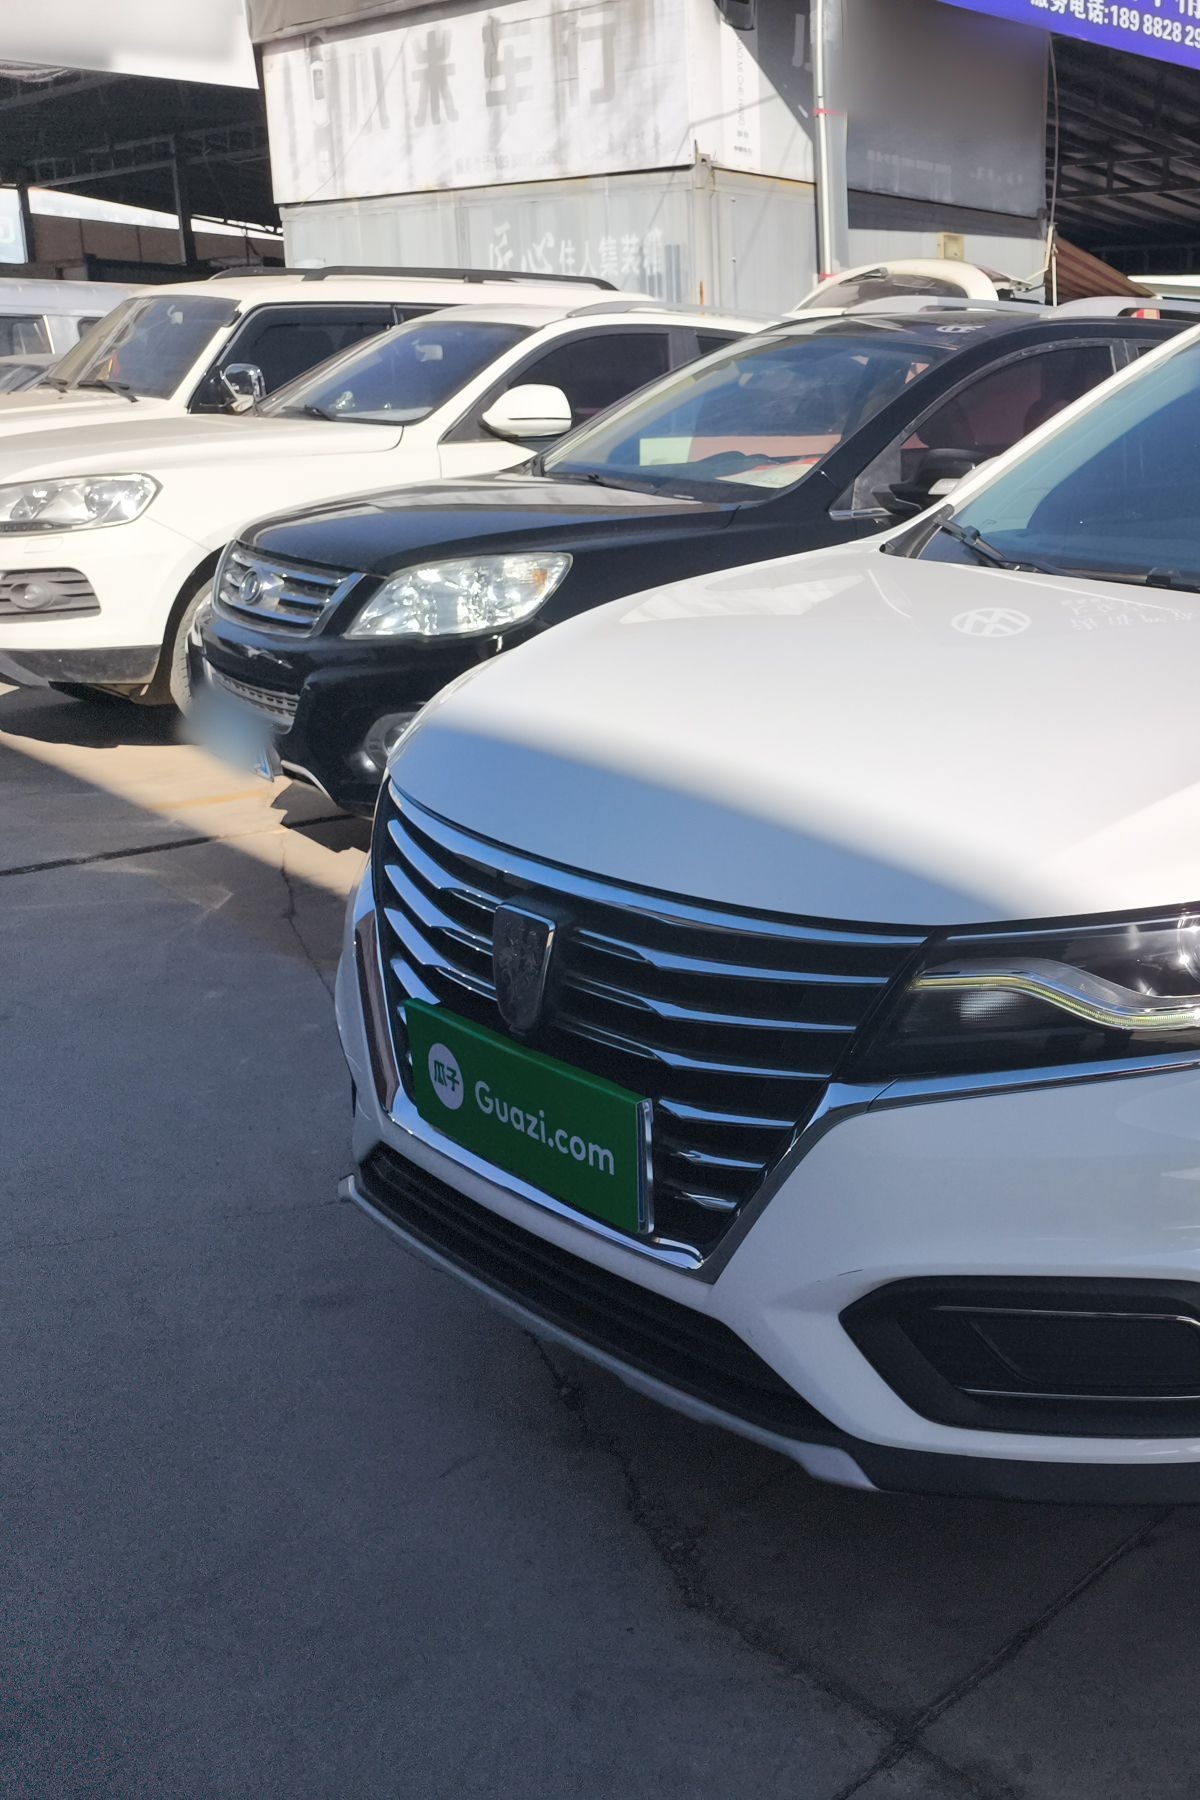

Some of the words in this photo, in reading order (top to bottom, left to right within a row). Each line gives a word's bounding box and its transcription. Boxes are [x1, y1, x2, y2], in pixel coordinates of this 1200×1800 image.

[1143, 14, 1182, 43] 8828
[433, 1059, 460, 1092] 瓜子
[474, 1080, 615, 1176] Guazi.com
